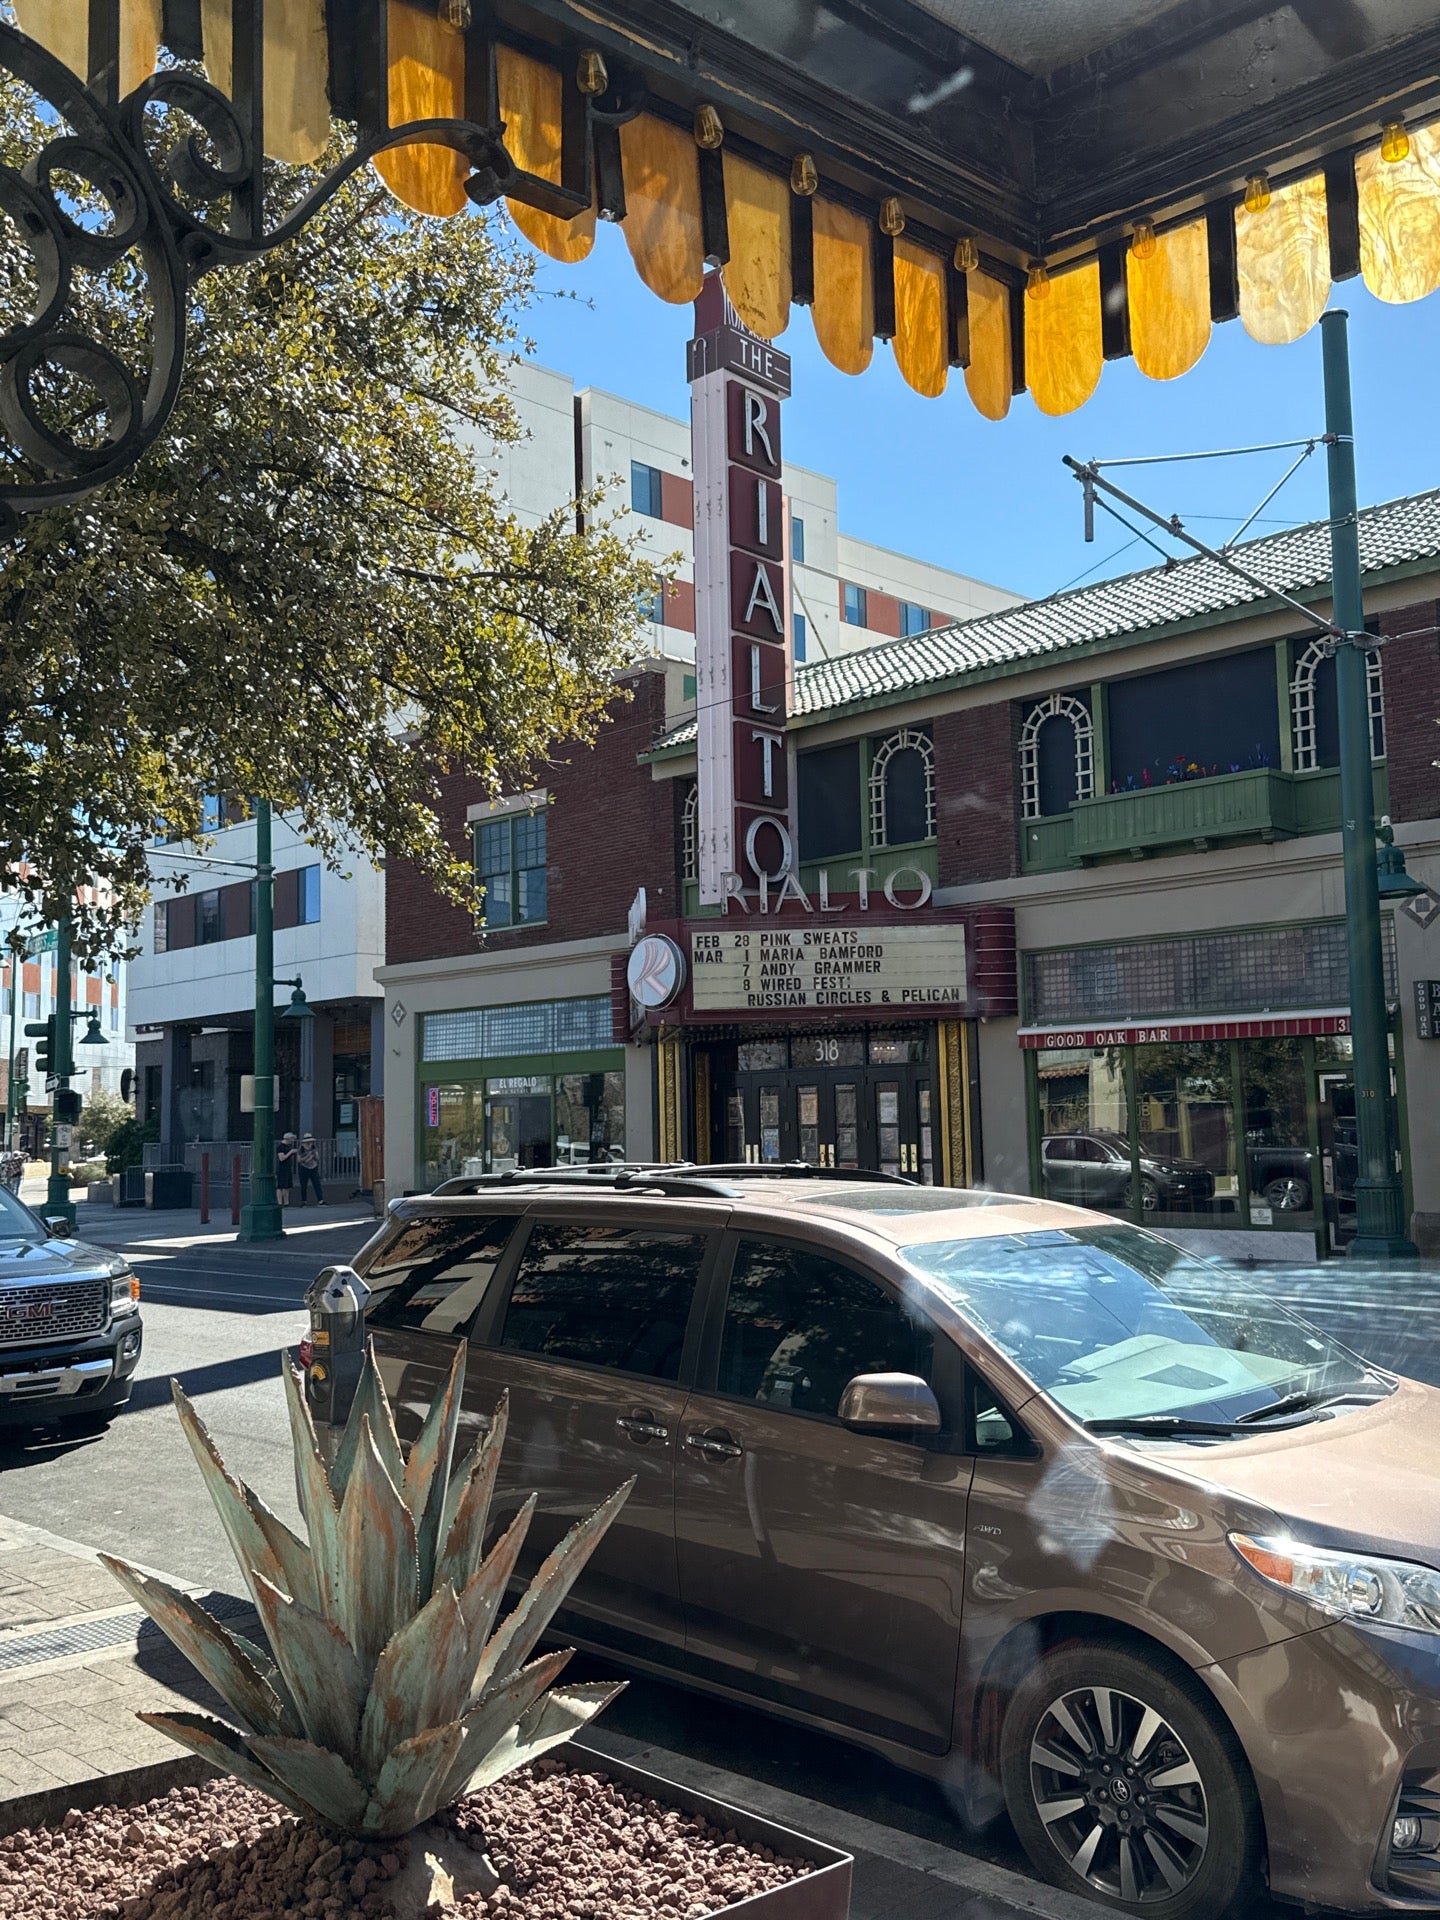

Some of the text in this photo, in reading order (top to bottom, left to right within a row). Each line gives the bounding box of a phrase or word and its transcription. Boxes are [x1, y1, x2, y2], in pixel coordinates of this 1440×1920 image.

[740, 338, 773, 379] THE
[744, 387, 793, 883] RIALTO
[720, 866, 932, 916] RIALTO
[696, 931, 858, 948] FEB 28 PINK SWEATS
[694, 950, 723, 963] MAR
[760, 948, 804, 961] MARIA
[820, 945, 883, 960] BAMFORD
[742, 960, 881, 976] 7 ANDY GRAMMER
[743, 979, 750, 991] 8
[760, 977, 801, 991] WIRED
[747, 988, 960, 1006] RUSSIAN CIRCLES & PELICAN
[1417, 982, 1428, 1037] GOOD OAK
[1047, 1029, 1168, 1047] GOOD OAK BAR
[815, 1039, 839, 1061] 318
[499, 1077, 537, 1089] EL REGALO
[1361, 1090, 1375, 1098] 310
[7, 1300, 68, 1320] GMC
[972, 1524, 1002, 1535] AWD
